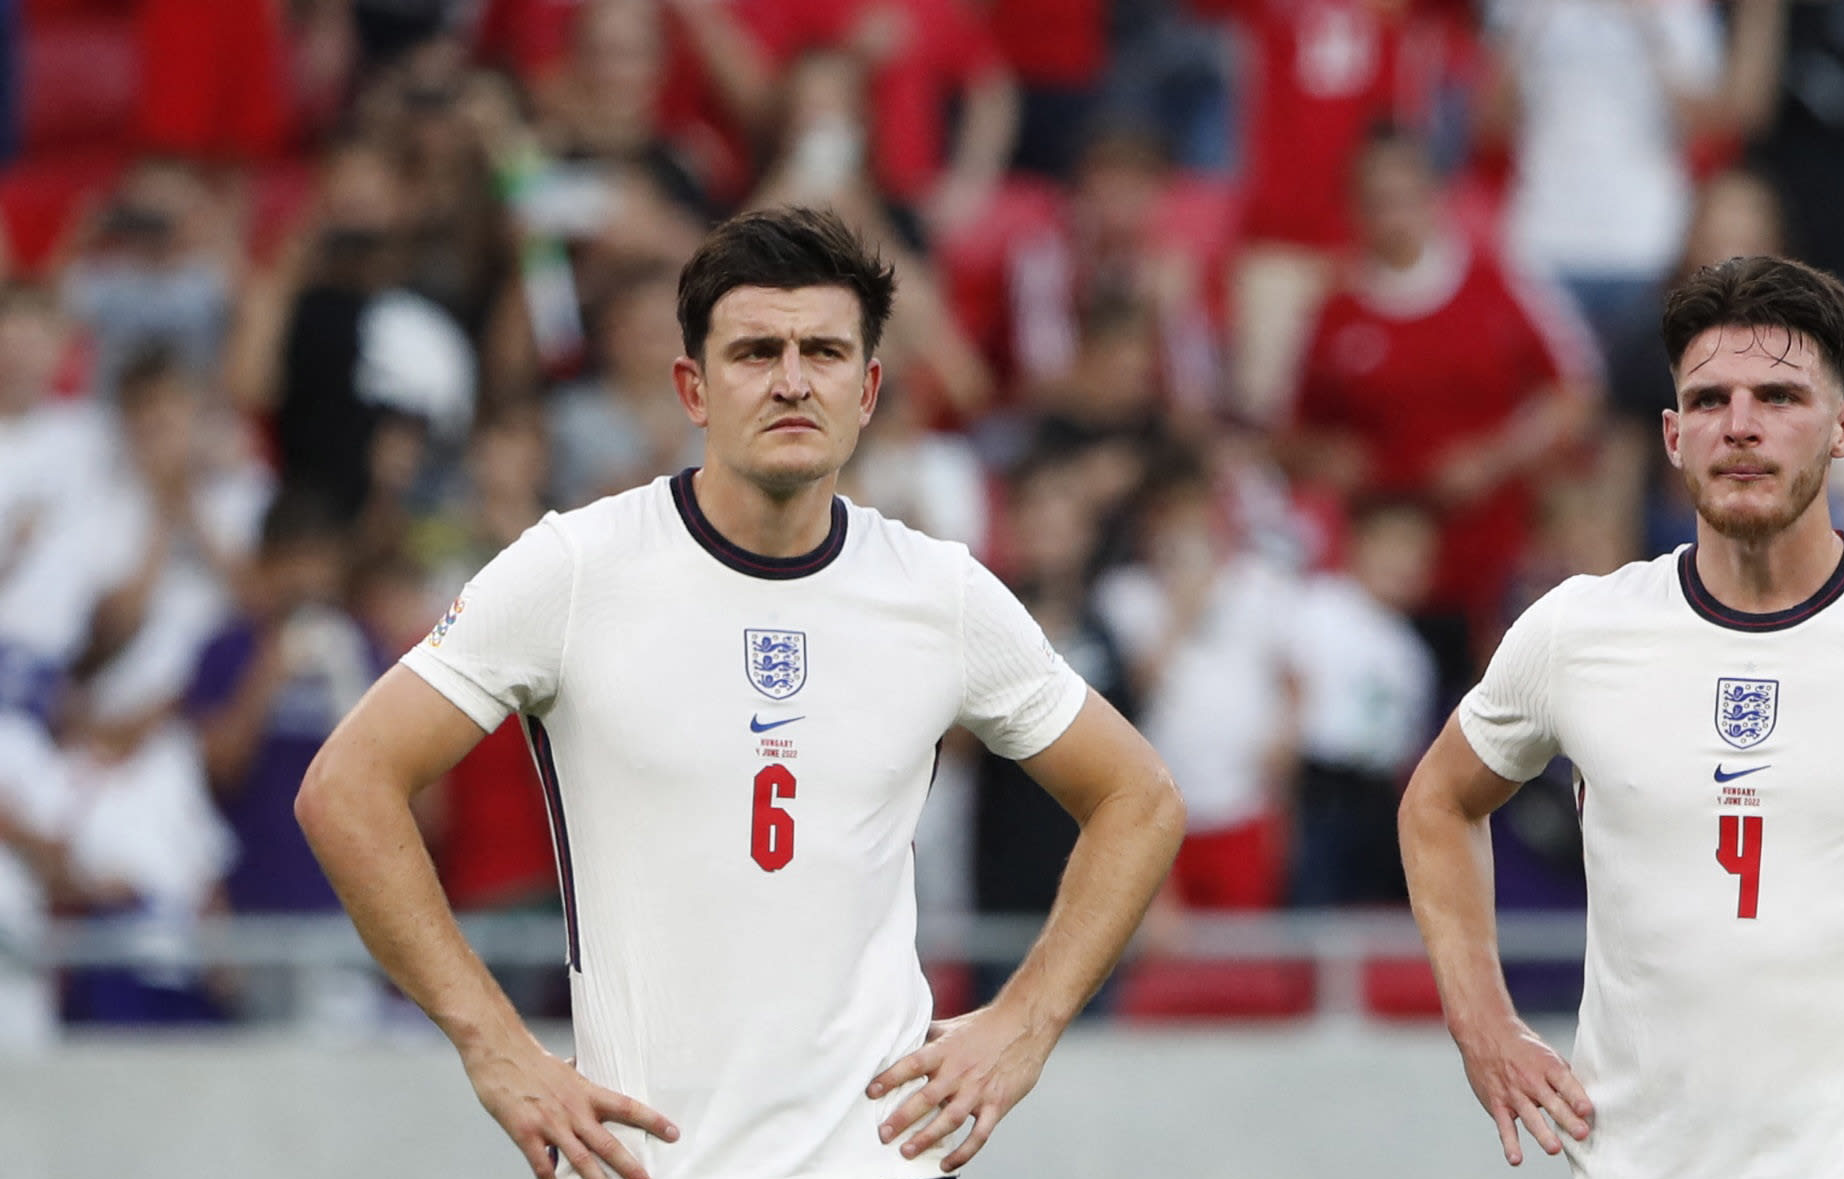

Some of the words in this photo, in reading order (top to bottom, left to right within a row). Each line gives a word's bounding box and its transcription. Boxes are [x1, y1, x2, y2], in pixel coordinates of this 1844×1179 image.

[750, 763, 797, 872] 6
[1722, 787, 1756, 796] HUNGARY
[1716, 815, 1763, 919] 4
